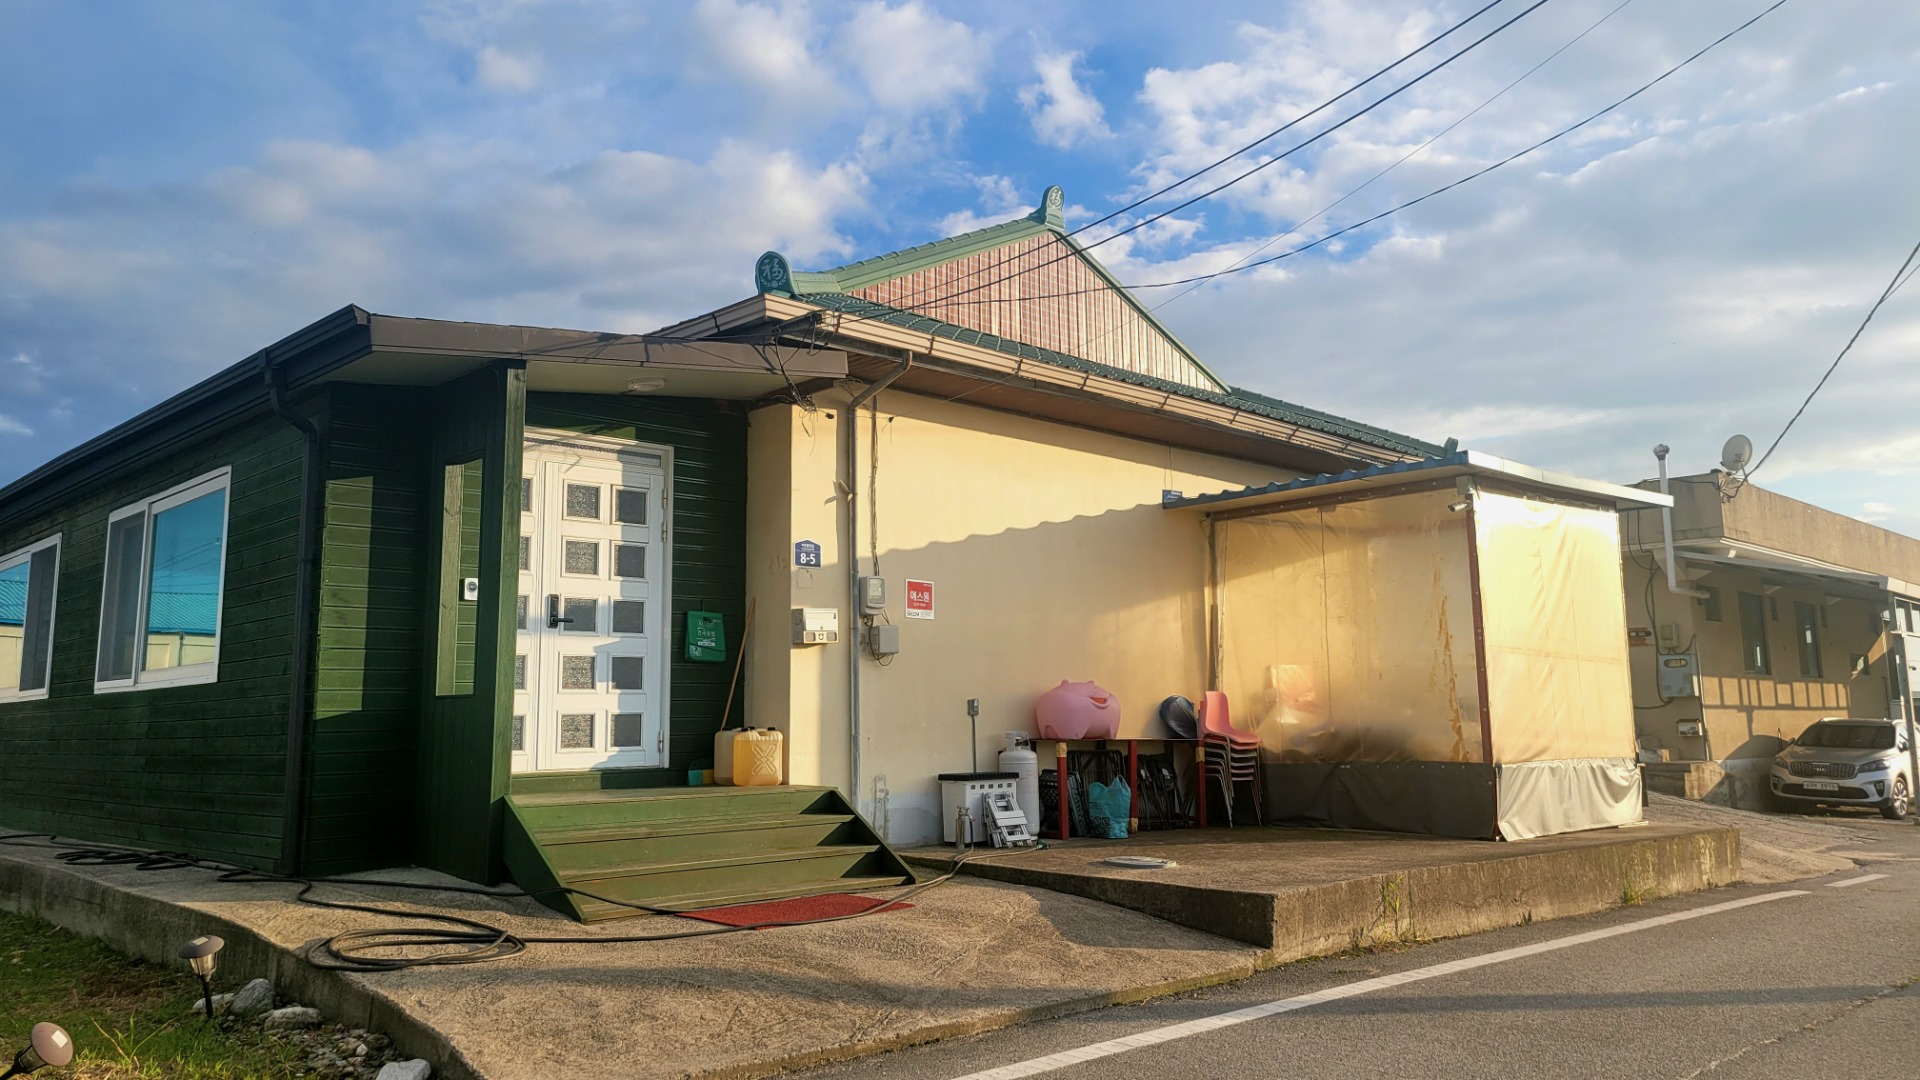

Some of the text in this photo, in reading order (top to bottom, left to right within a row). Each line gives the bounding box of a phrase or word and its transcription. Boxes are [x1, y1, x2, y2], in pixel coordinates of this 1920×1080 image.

[762, 258, 783, 280] 福
[800, 552, 816, 565] 8-5
[909, 590, 930, 603] 에스원
